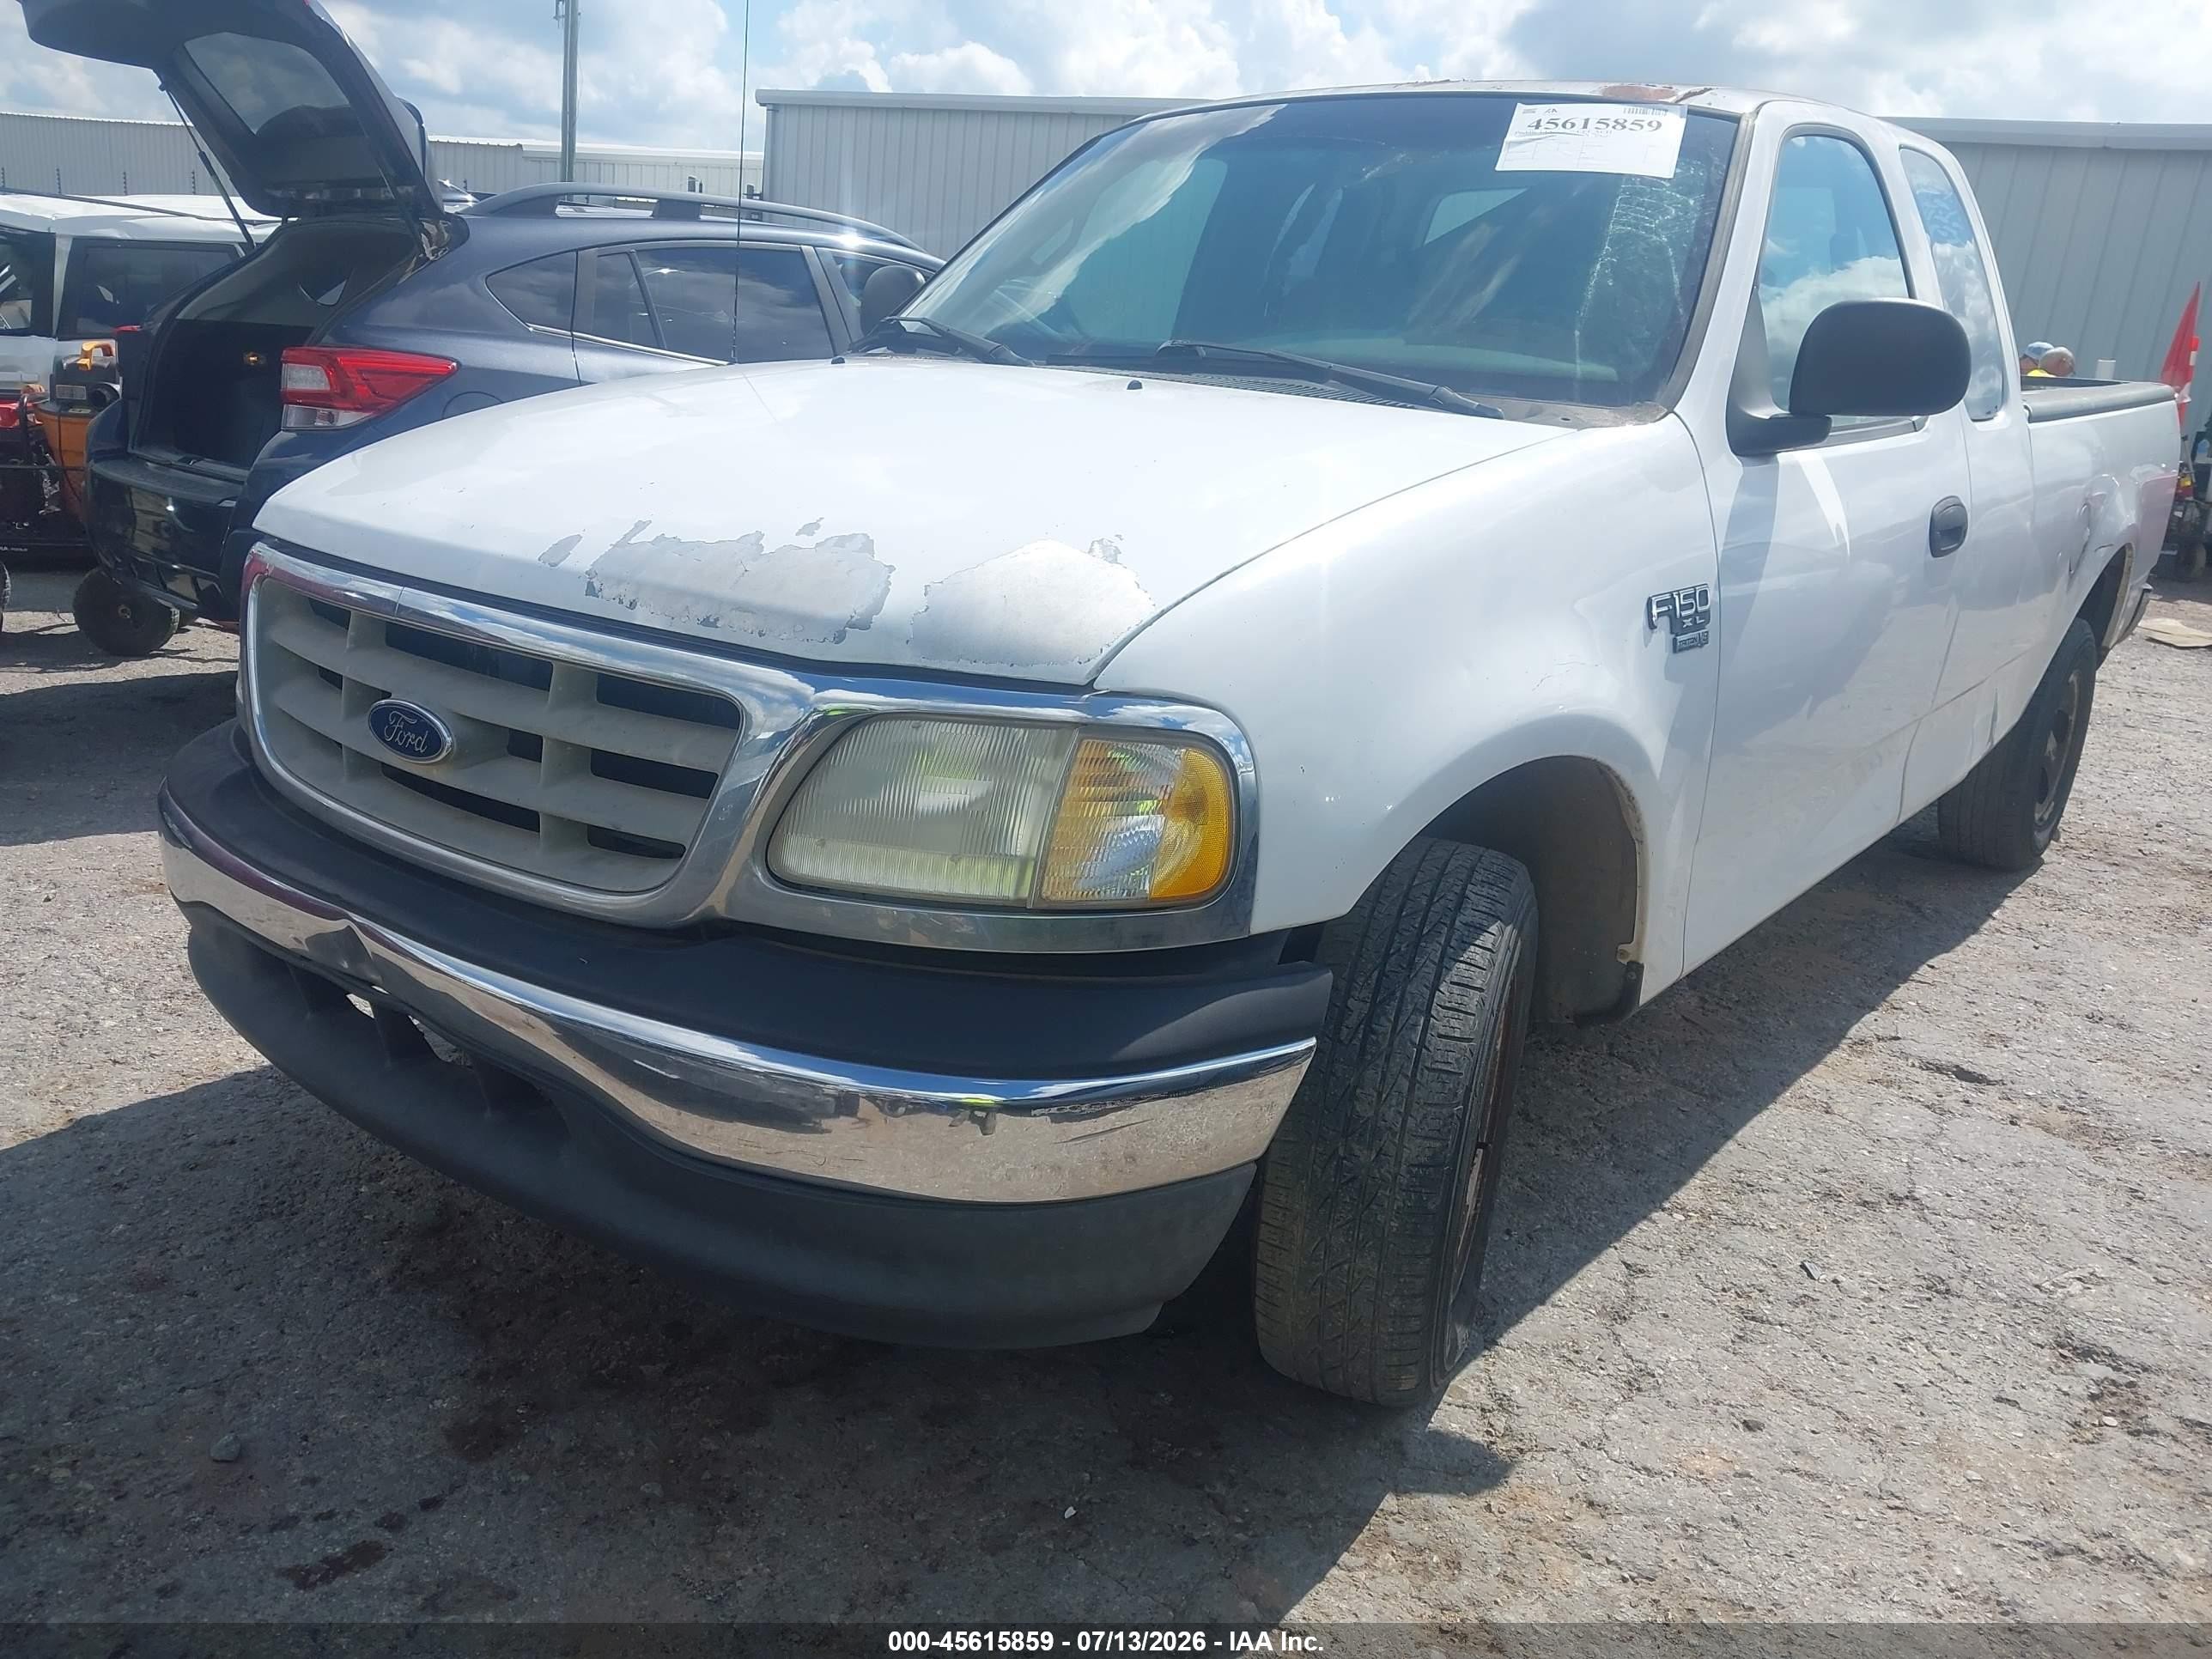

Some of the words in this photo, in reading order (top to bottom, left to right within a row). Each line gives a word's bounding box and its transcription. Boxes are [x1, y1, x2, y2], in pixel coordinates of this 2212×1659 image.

[1527, 117, 1662, 132] 45615859
[1682, 616, 1705, 629] XL
[384, 710, 428, 753] Ford
